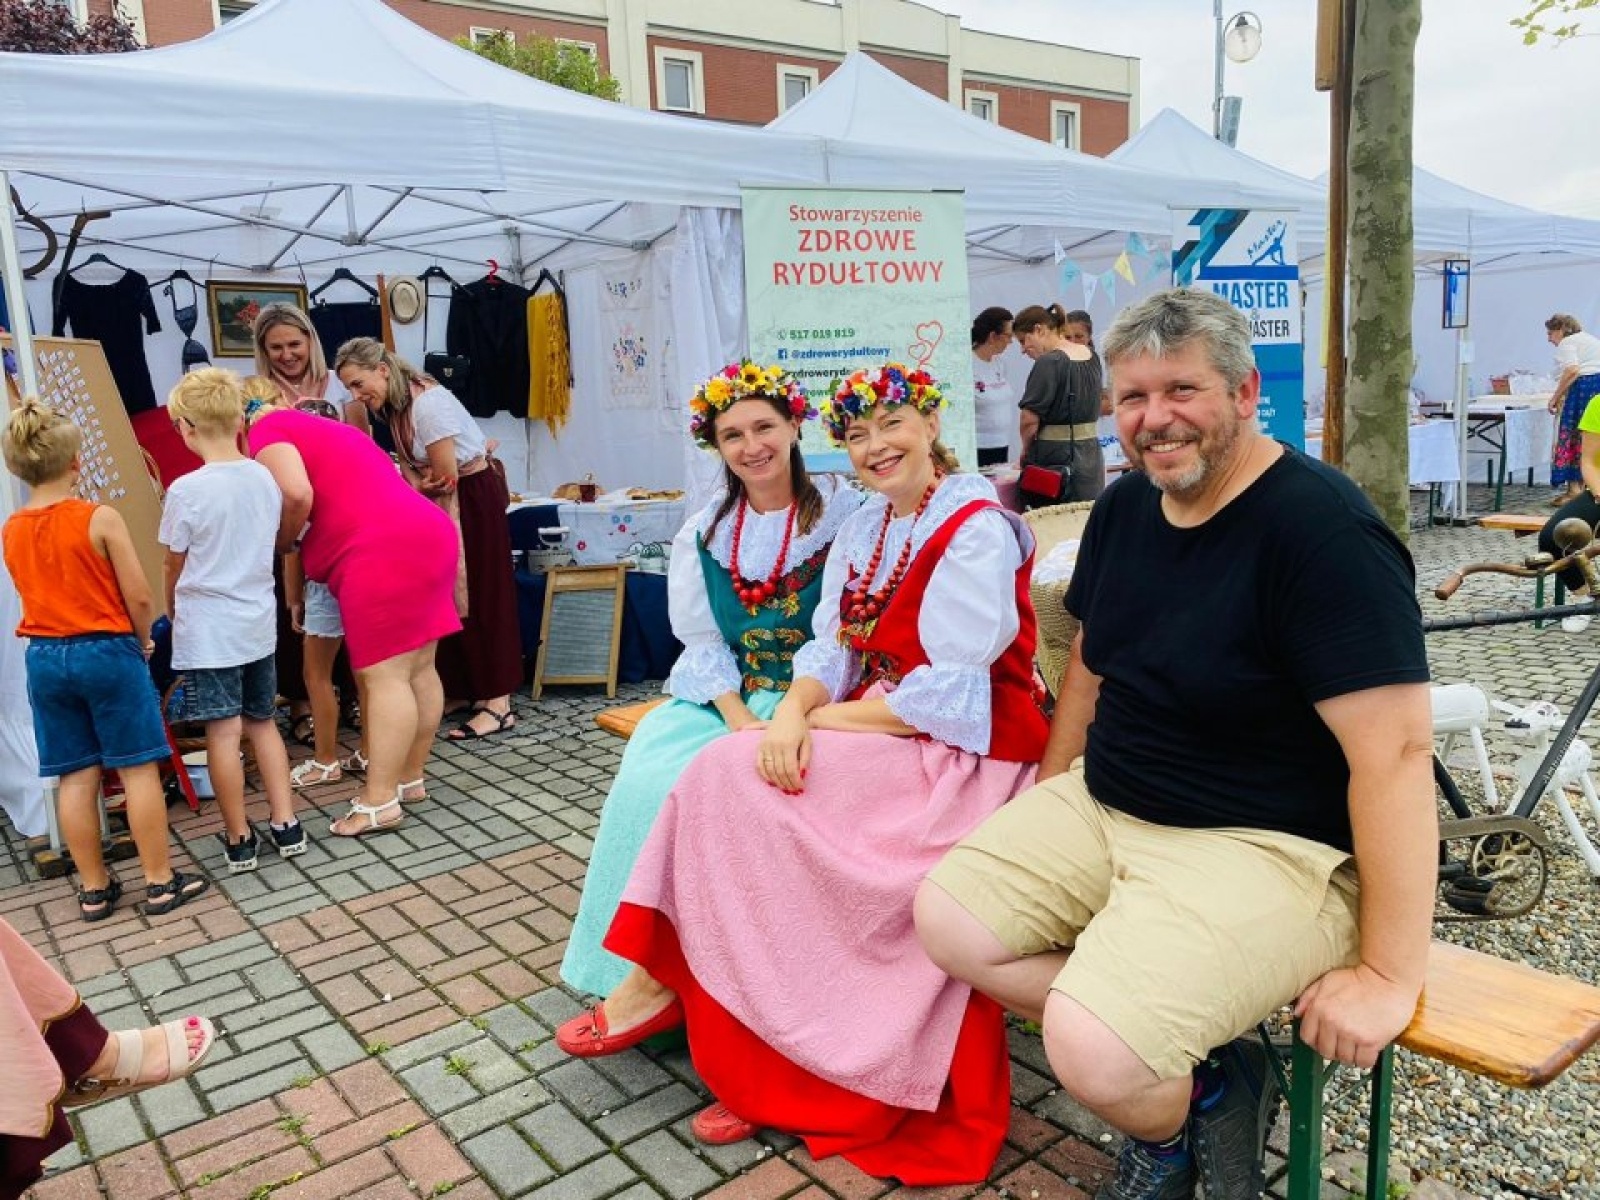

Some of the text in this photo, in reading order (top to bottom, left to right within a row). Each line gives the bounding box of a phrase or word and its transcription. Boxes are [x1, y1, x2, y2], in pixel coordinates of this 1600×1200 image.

[789, 204, 922, 225] Stowarzyszenie
[798, 229, 917, 252] ZDROWE
[773, 260, 943, 286] RYDUŁTOWY
[789, 328, 855, 339] 517 019 819
